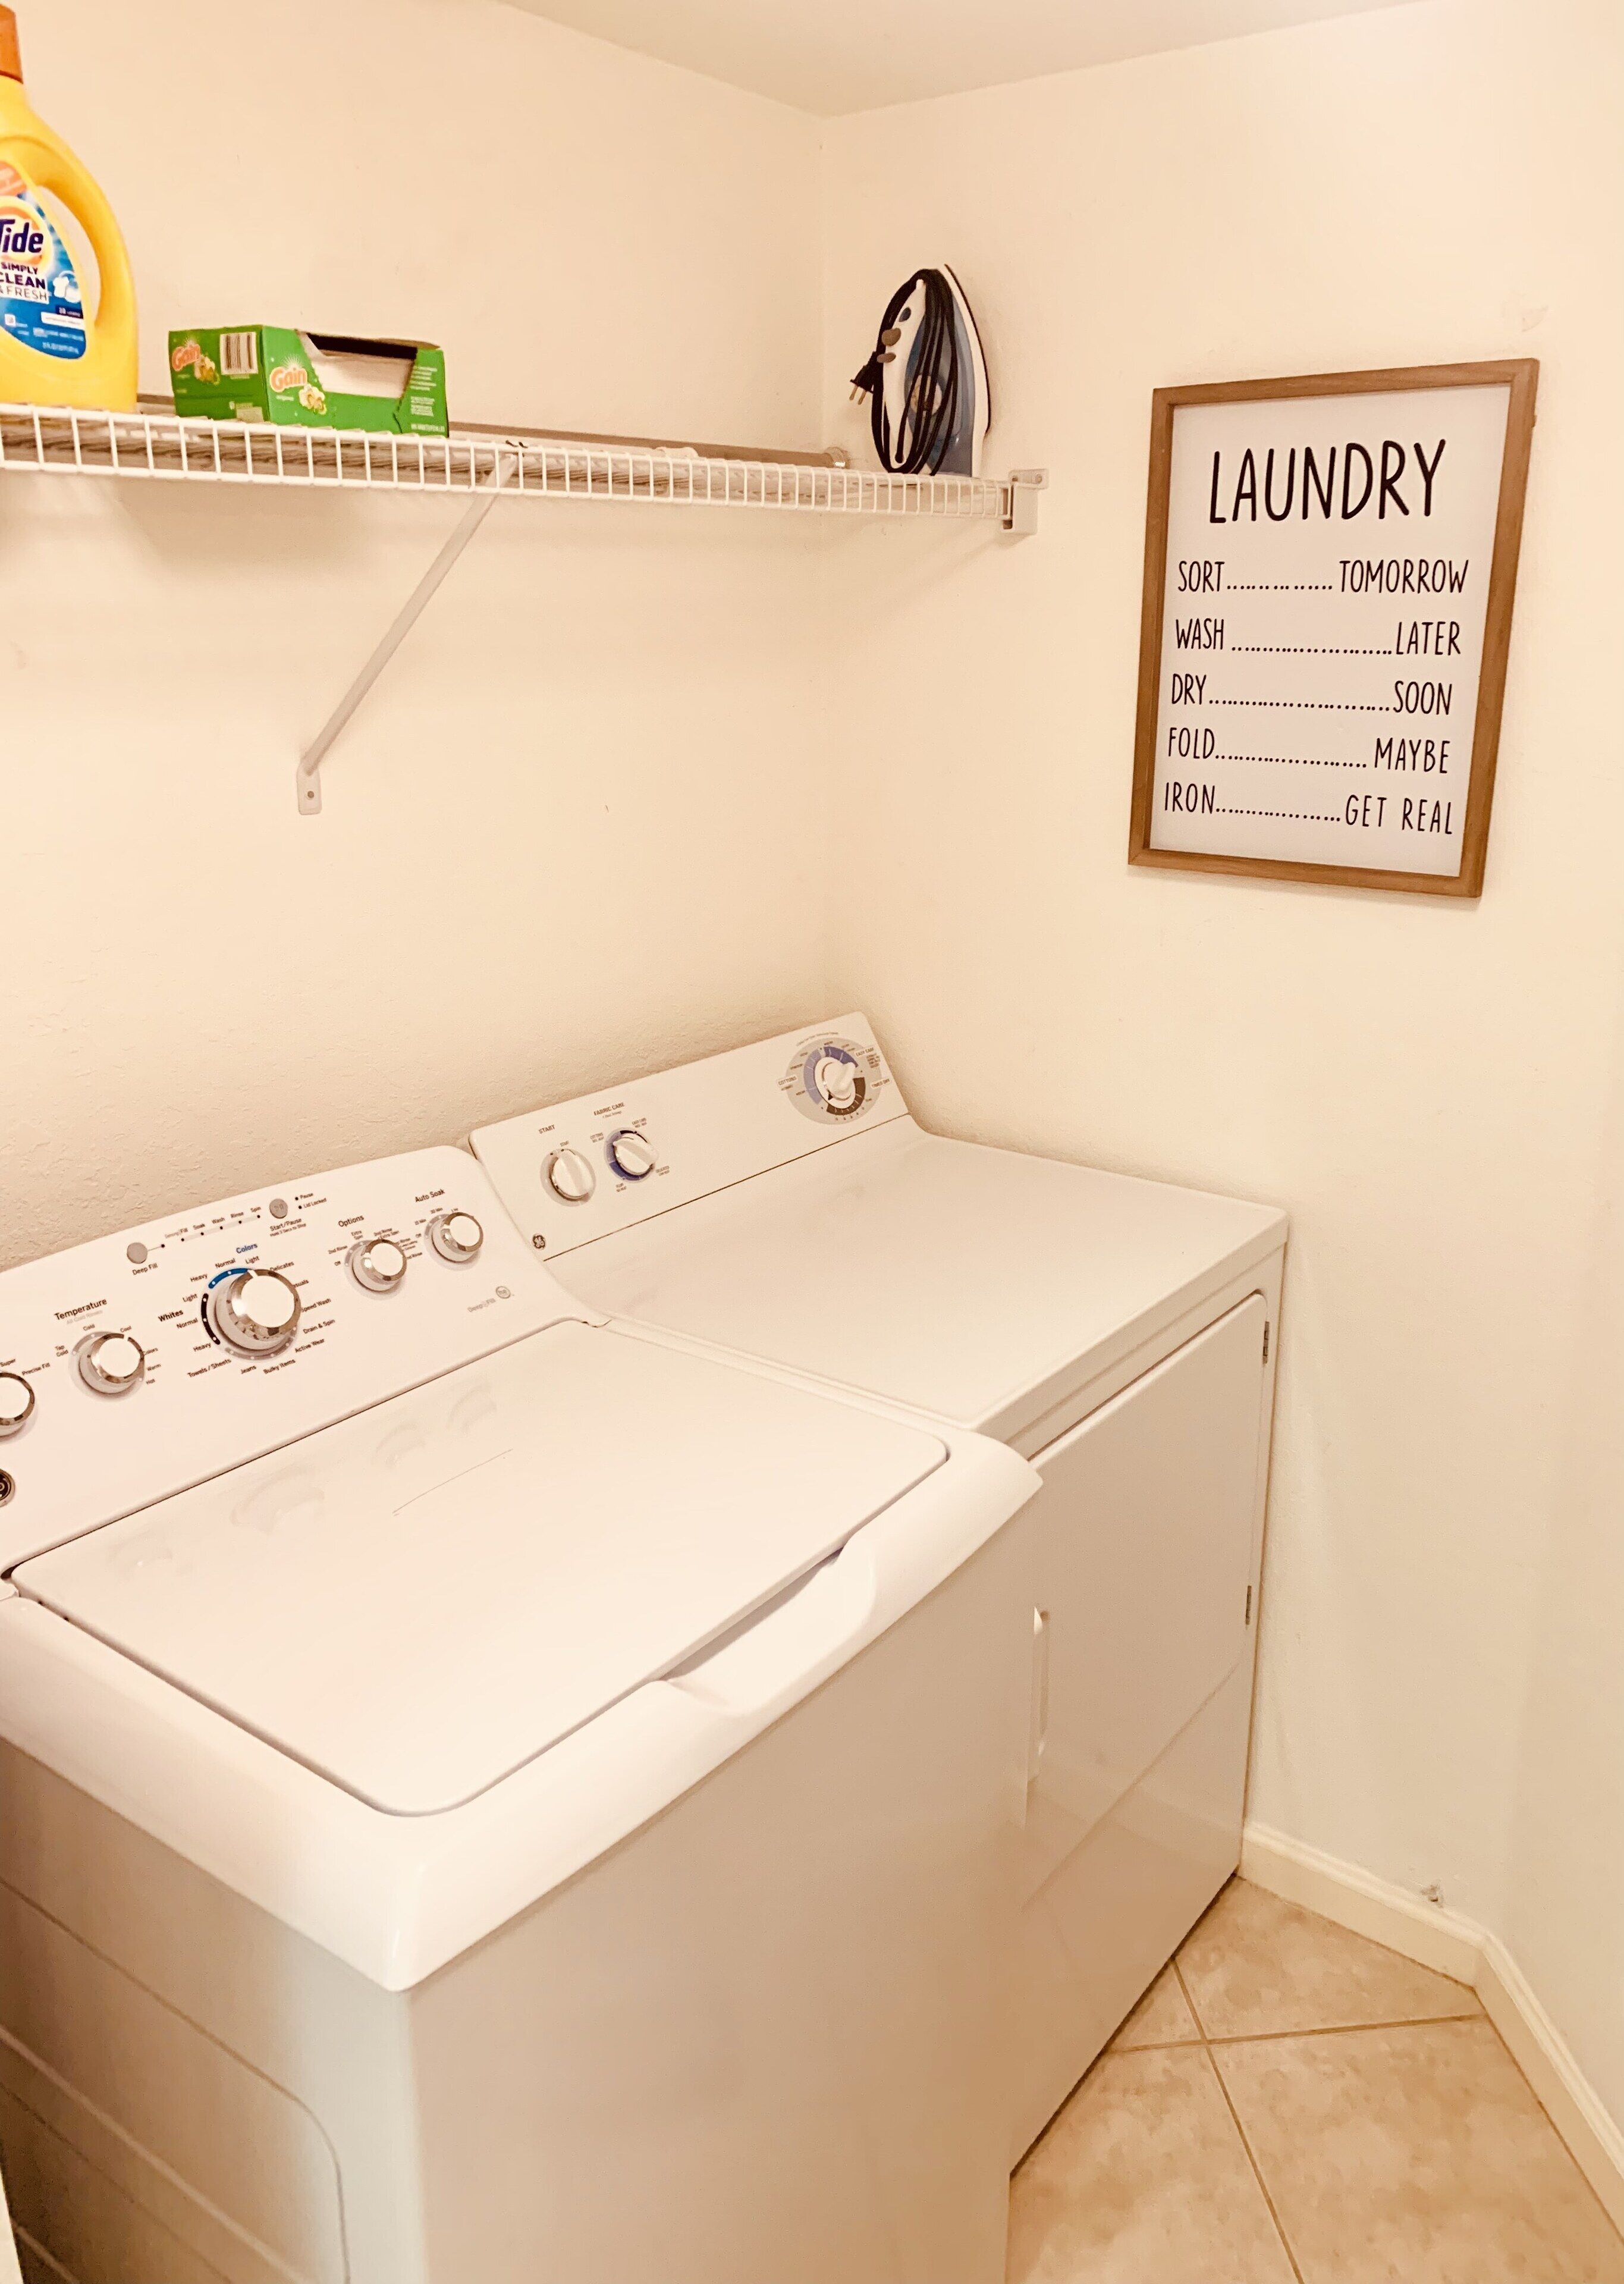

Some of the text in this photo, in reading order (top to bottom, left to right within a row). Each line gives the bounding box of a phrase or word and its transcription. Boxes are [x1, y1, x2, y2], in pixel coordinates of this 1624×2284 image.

[0, 219, 43, 253] Tide
[1, 262, 38, 275] SIMPLY
[7, 286, 47, 301] FRESH
[271, 366, 308, 392] Gain
[1210, 440, 1445, 523] LAUNDRY
[1178, 559, 1468, 594] SORT TOMORROW
[1176, 618, 1460, 655] WASH LATER
[1172, 674, 1452, 715] DRY SOON
[1168, 727, 1450, 773] FOLD MAYBE
[1165, 782, 1452, 834] IRON GET REAL
[593, 1107, 612, 1116] FABRIC
[611, 1102, 626, 1111] CARE
[538, 1124, 555, 1135] START
[414, 1188, 445, 1203] Auto Soak
[212, 1216, 225, 1225] Wash
[269, 1218, 302, 1231] Start/Pause
[338, 1215, 365, 1227] Options
[235, 1243, 258, 1254] Colors
[215, 1257, 236, 1269] Normal
[245, 1255, 260, 1265] Light
[270, 1261, 294, 1272] Delicates
[132, 1266, 147, 1275] Deep
[190, 1273, 208, 1282] Heavy
[182, 1293, 198, 1303] Light
[54, 1298, 107, 1320] Temperature
[300, 1298, 332, 1313] Speed Wash
[158, 1310, 184, 1322] Whites
[177, 1317, 198, 1329] Normal
[303, 1324, 318, 1334] Drain
[323, 1319, 336, 1328] Spin
[193, 1342, 212, 1352] Heavy
[295, 1338, 325, 1353] Active Wear
[0, 1359, 15, 1367] Super
[147, 1363, 162, 1371] Warm
[187, 1366, 208, 1378] Towels
[211, 1359, 232, 1370] Sheets
[241, 1364, 257, 1375] Jeans
[263, 1359, 296, 1375] Bulky Items
[22, 1366, 42, 1375] Precise
